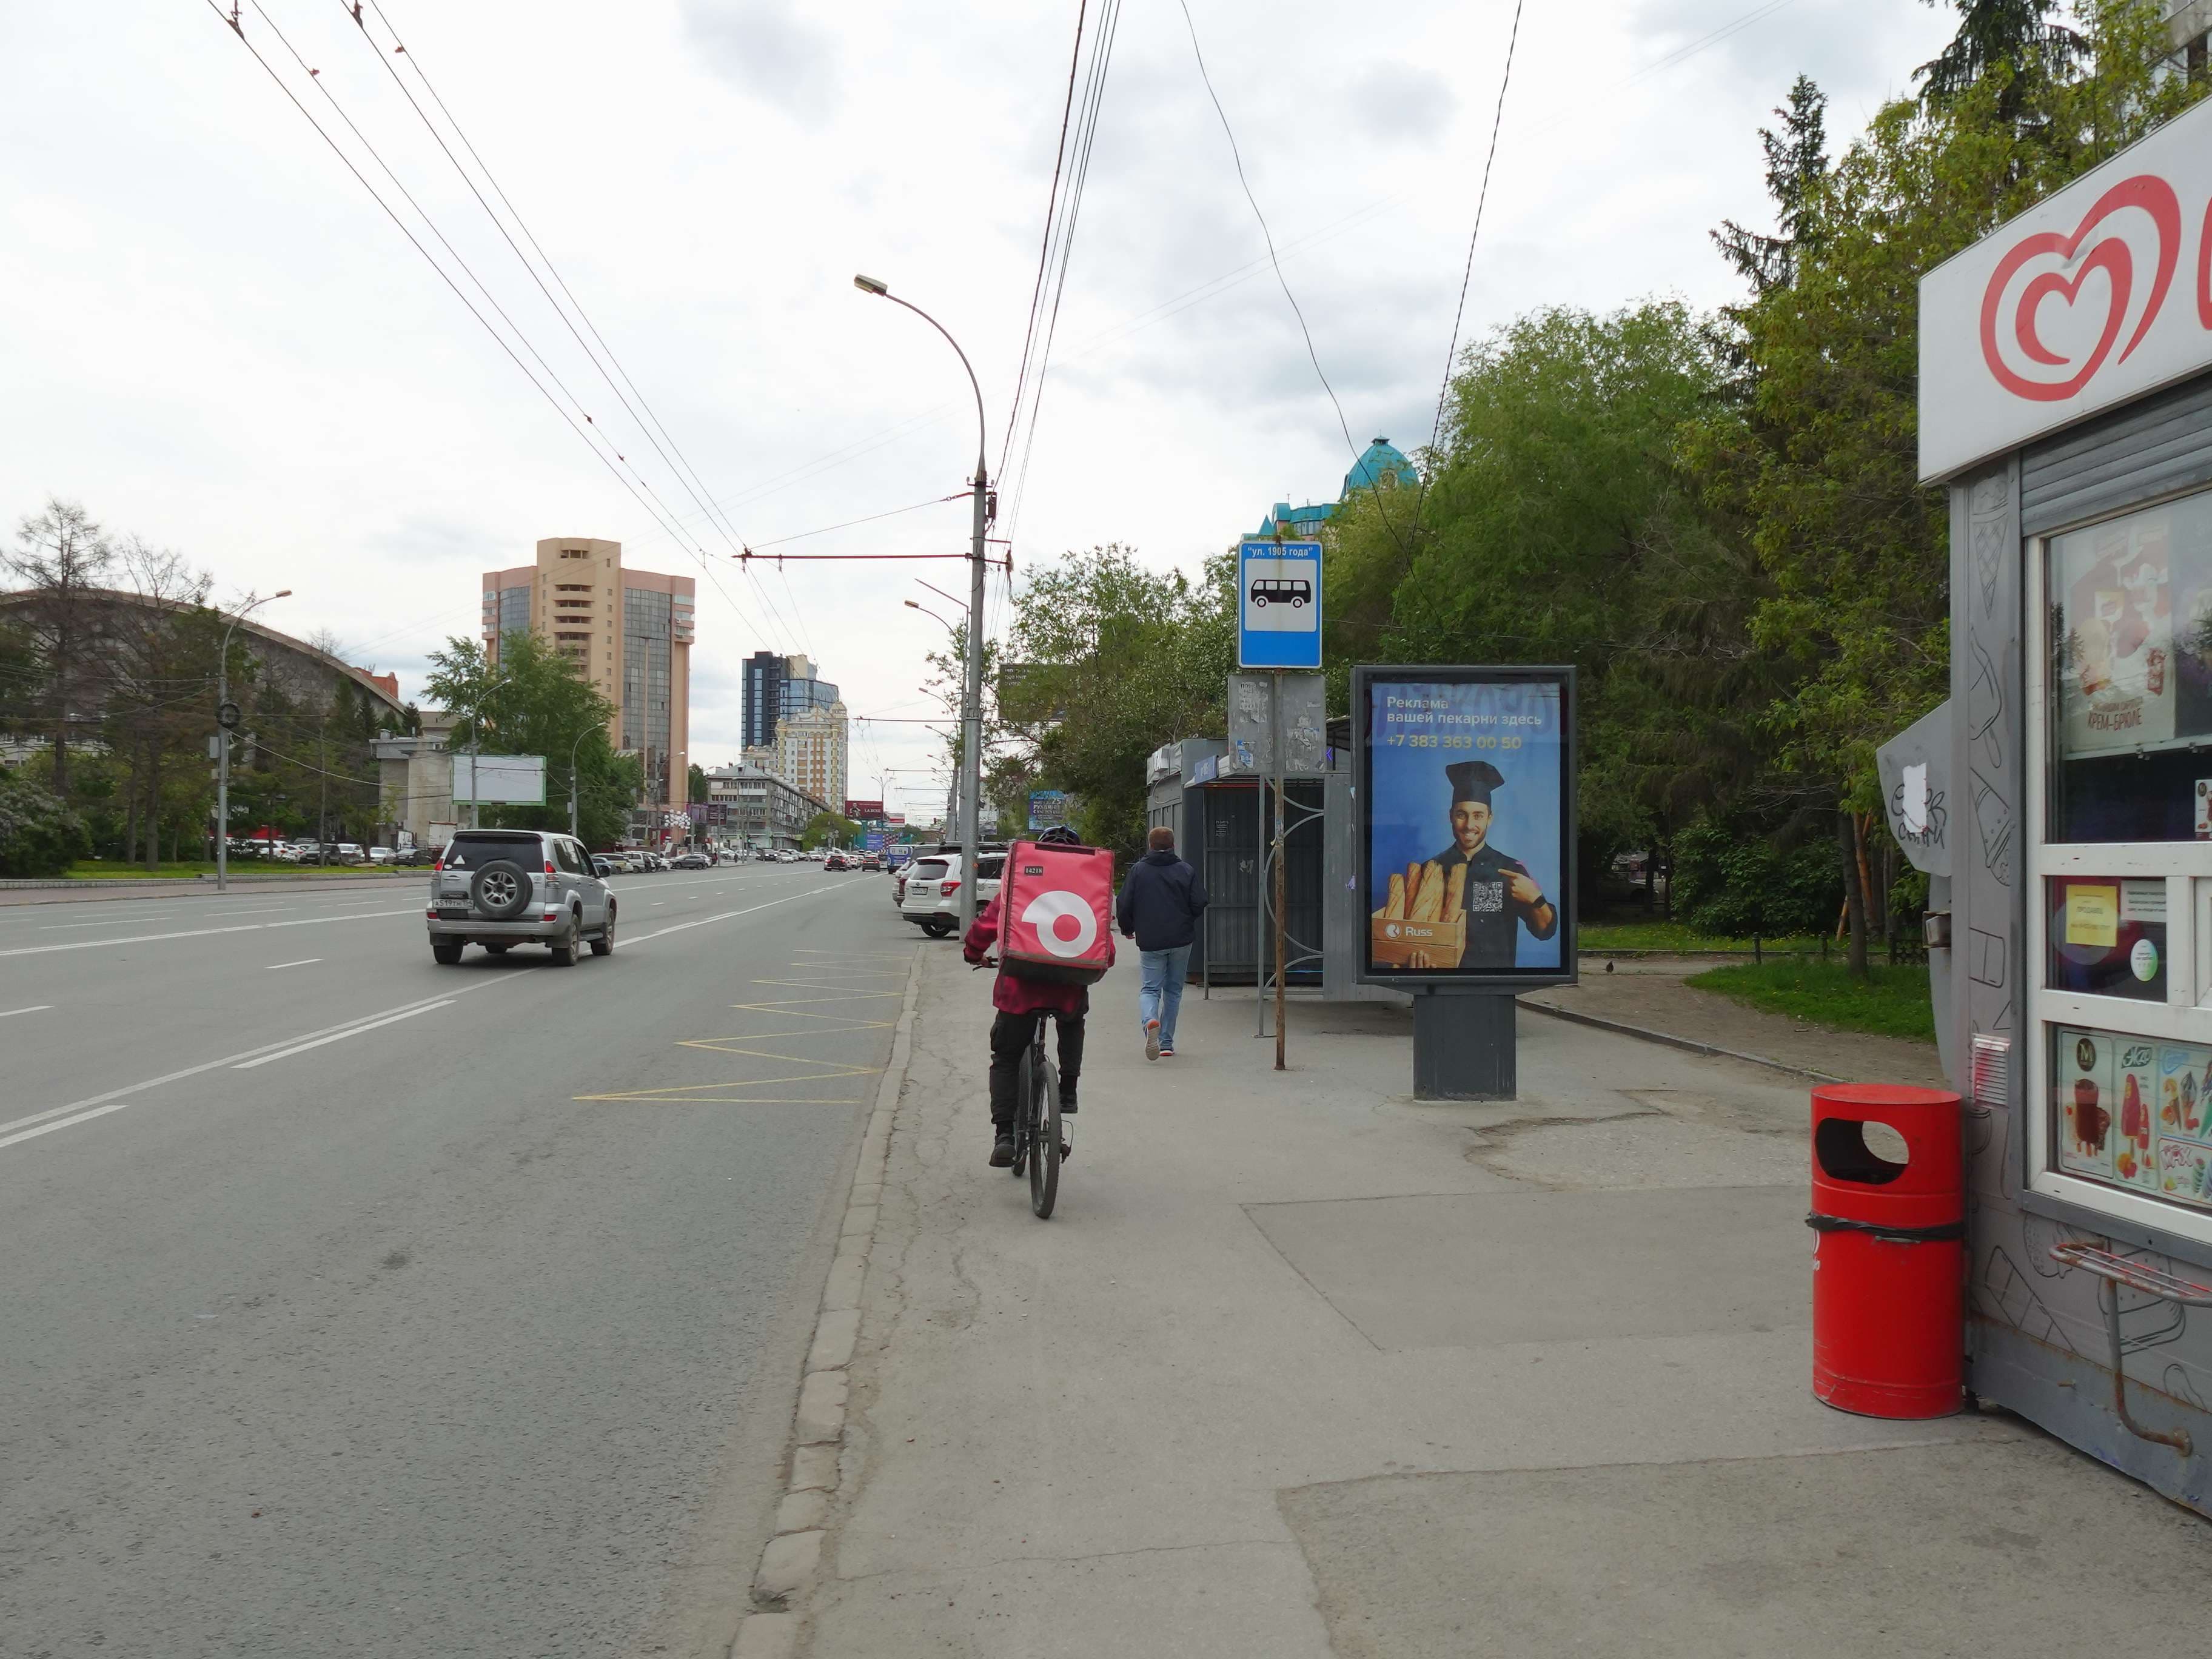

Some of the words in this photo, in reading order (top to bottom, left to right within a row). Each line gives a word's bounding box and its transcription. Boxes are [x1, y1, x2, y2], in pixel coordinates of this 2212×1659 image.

[1268, 547, 1287, 556] 1905
[1387, 696, 1449, 709] Реклама
[1387, 712, 1433, 724] вашей
[1438, 714, 1498, 725] пекарни
[1501, 715, 1542, 726] здесь
[1387, 734, 1405, 748] +7
[1409, 735, 1438, 748] 383
[1443, 736, 1472, 749] 363
[1476, 736, 1496, 749] 00
[1501, 737, 1522, 750] 50
[1405, 926, 1433, 937] Russ
